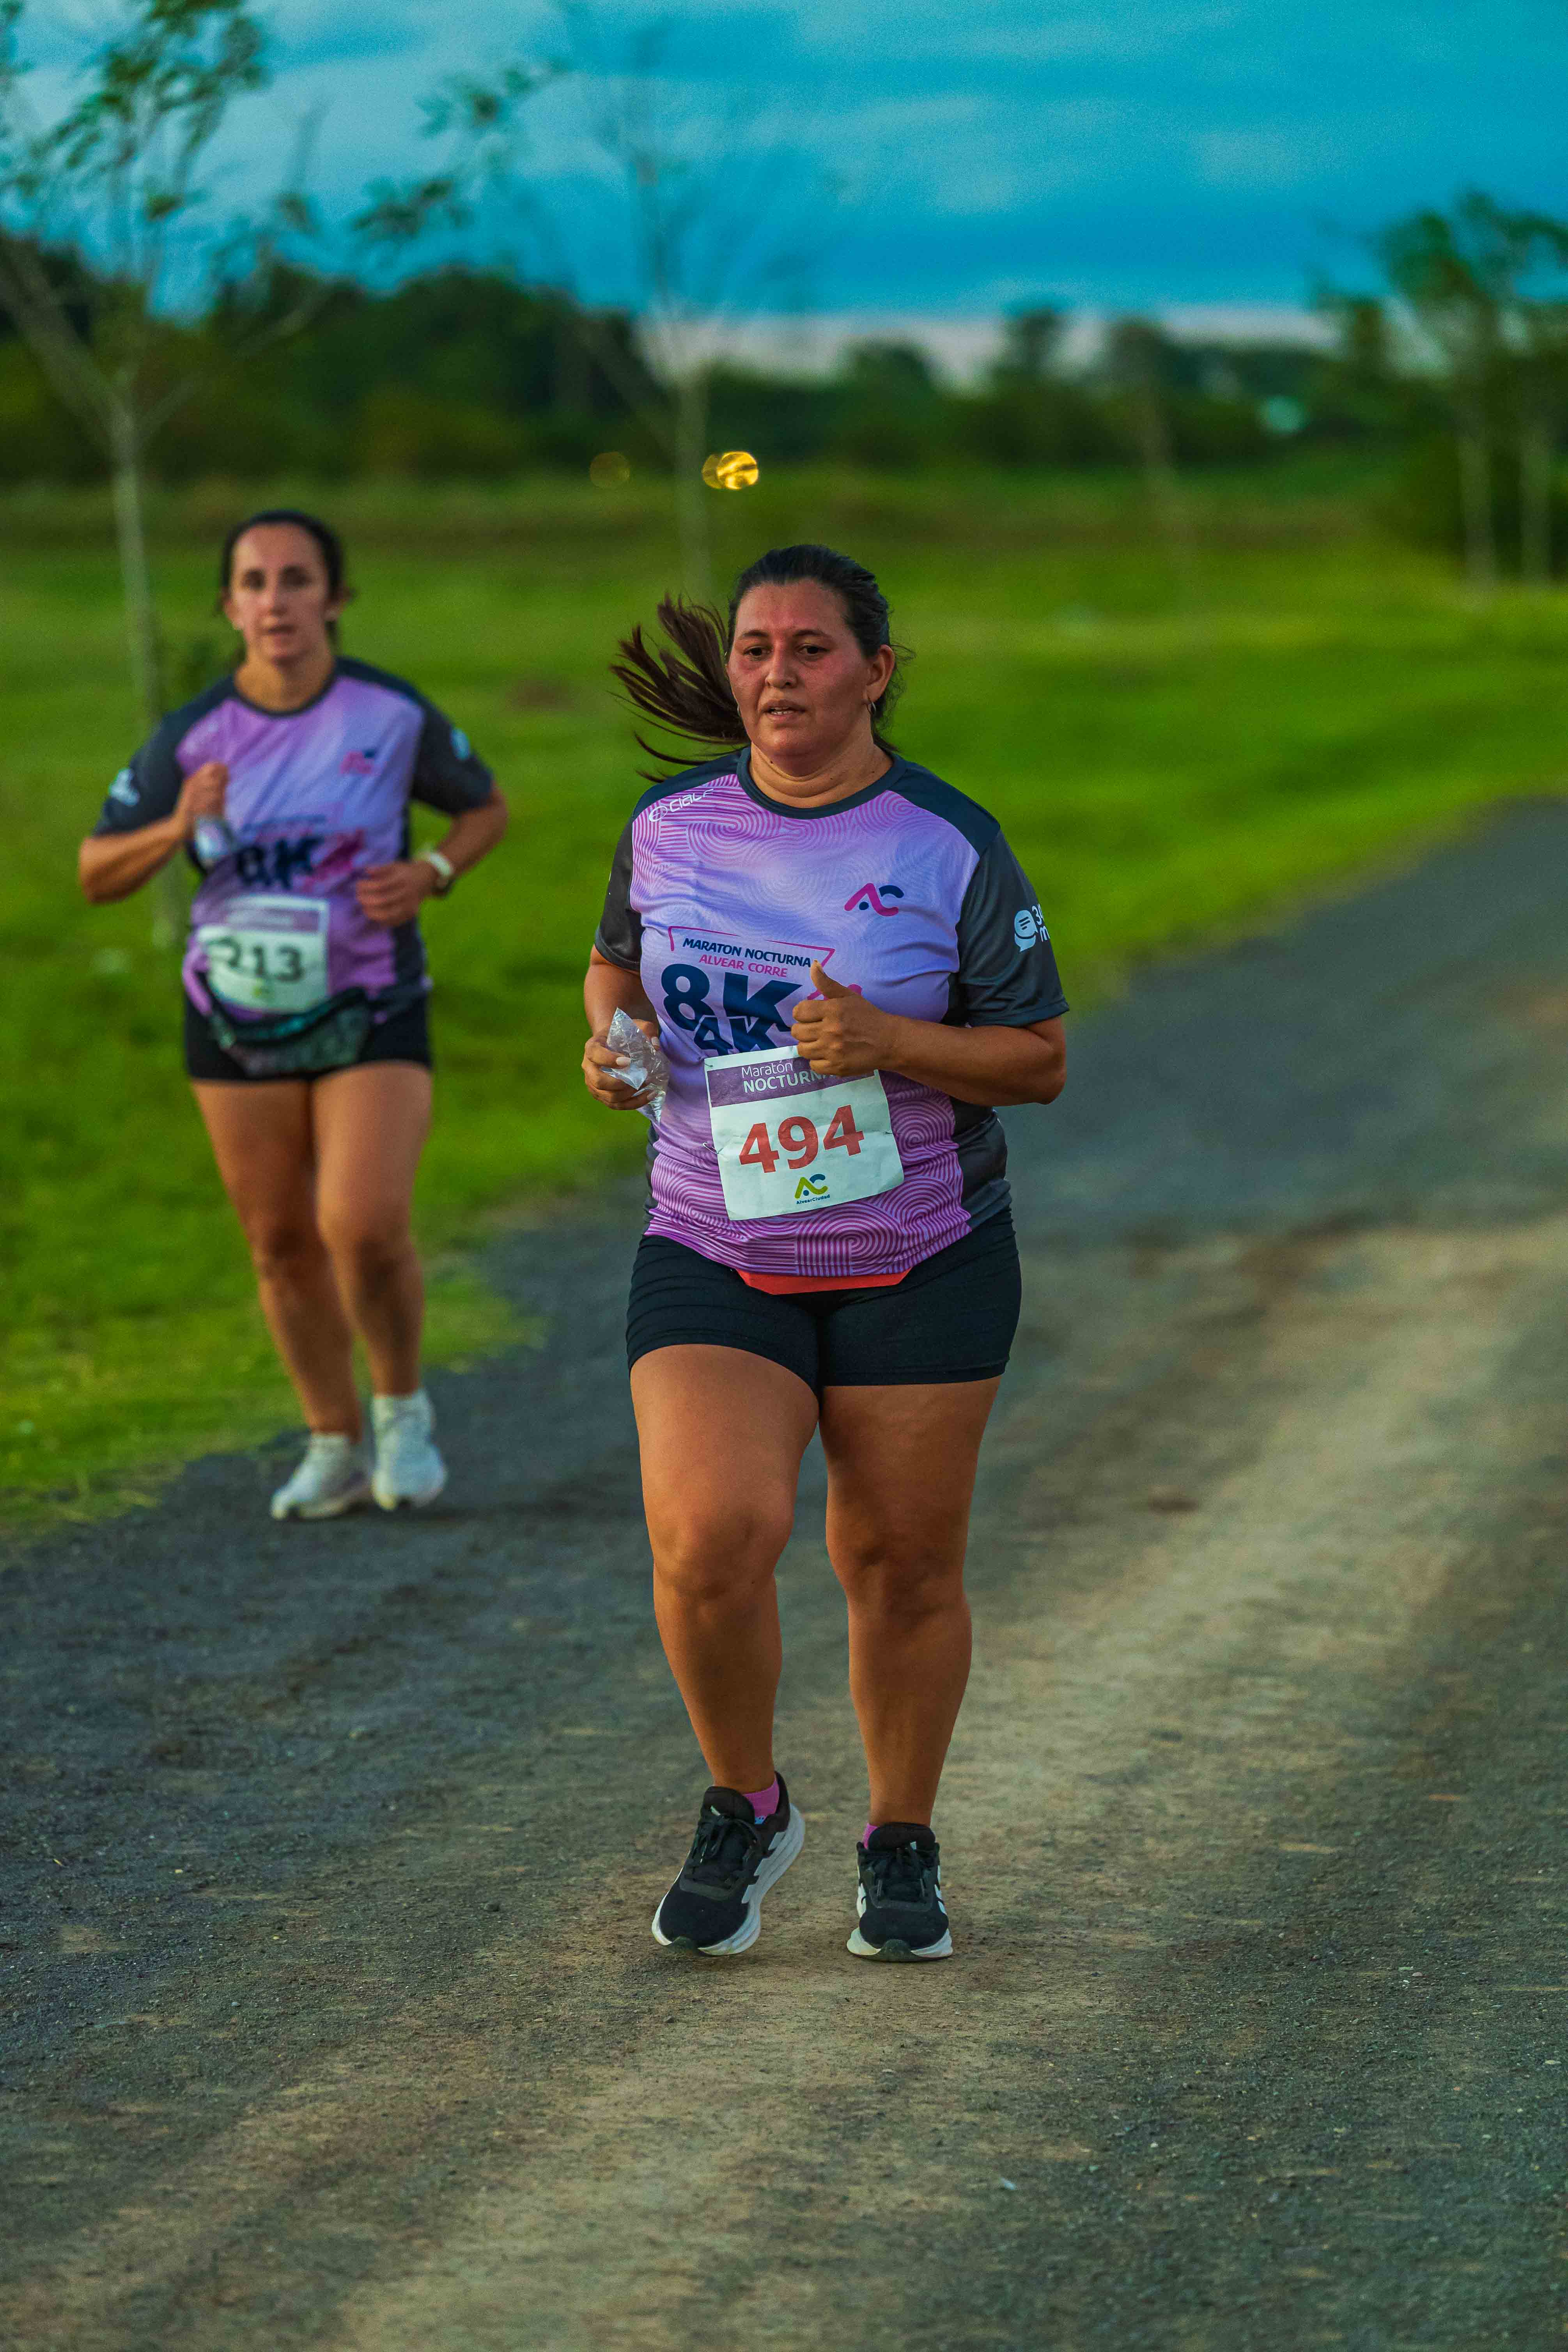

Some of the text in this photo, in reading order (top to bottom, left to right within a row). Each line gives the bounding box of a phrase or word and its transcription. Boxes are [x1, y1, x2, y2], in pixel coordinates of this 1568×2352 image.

[682, 937, 811, 968] MARATON NOCTURNA
[699, 954, 788, 978] ALVEAR CORRE
[661, 963, 803, 1033] 8K
[741, 1060, 793, 1079] Maratón
[743, 1070, 834, 1093] NOCTURN
[739, 1104, 865, 1173] 494
[796, 1194, 831, 1204] AlvearCiudad
